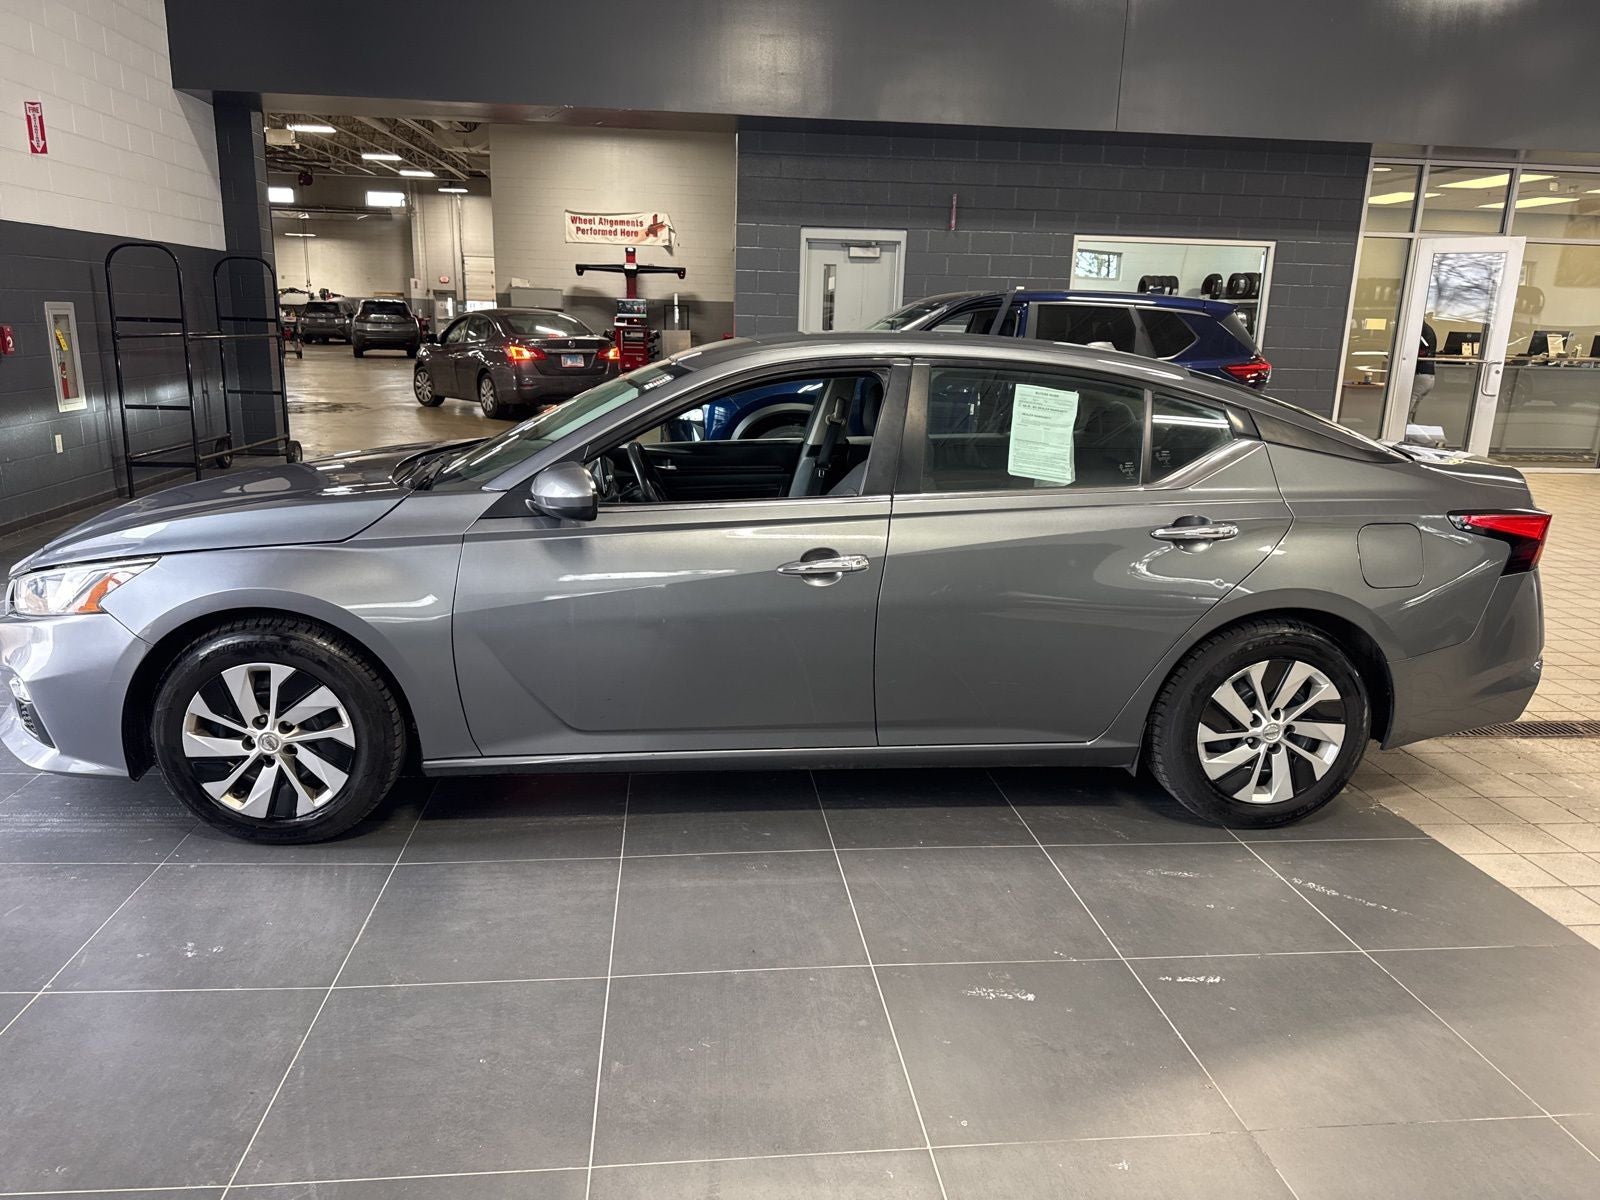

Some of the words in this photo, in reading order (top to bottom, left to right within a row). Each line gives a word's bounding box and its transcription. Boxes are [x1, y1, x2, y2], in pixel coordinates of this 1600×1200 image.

[570, 215, 595, 225] Wheel
[598, 217, 644, 227] Alignments
[576, 226, 618, 236] Performed
[620, 229, 639, 237] Here
